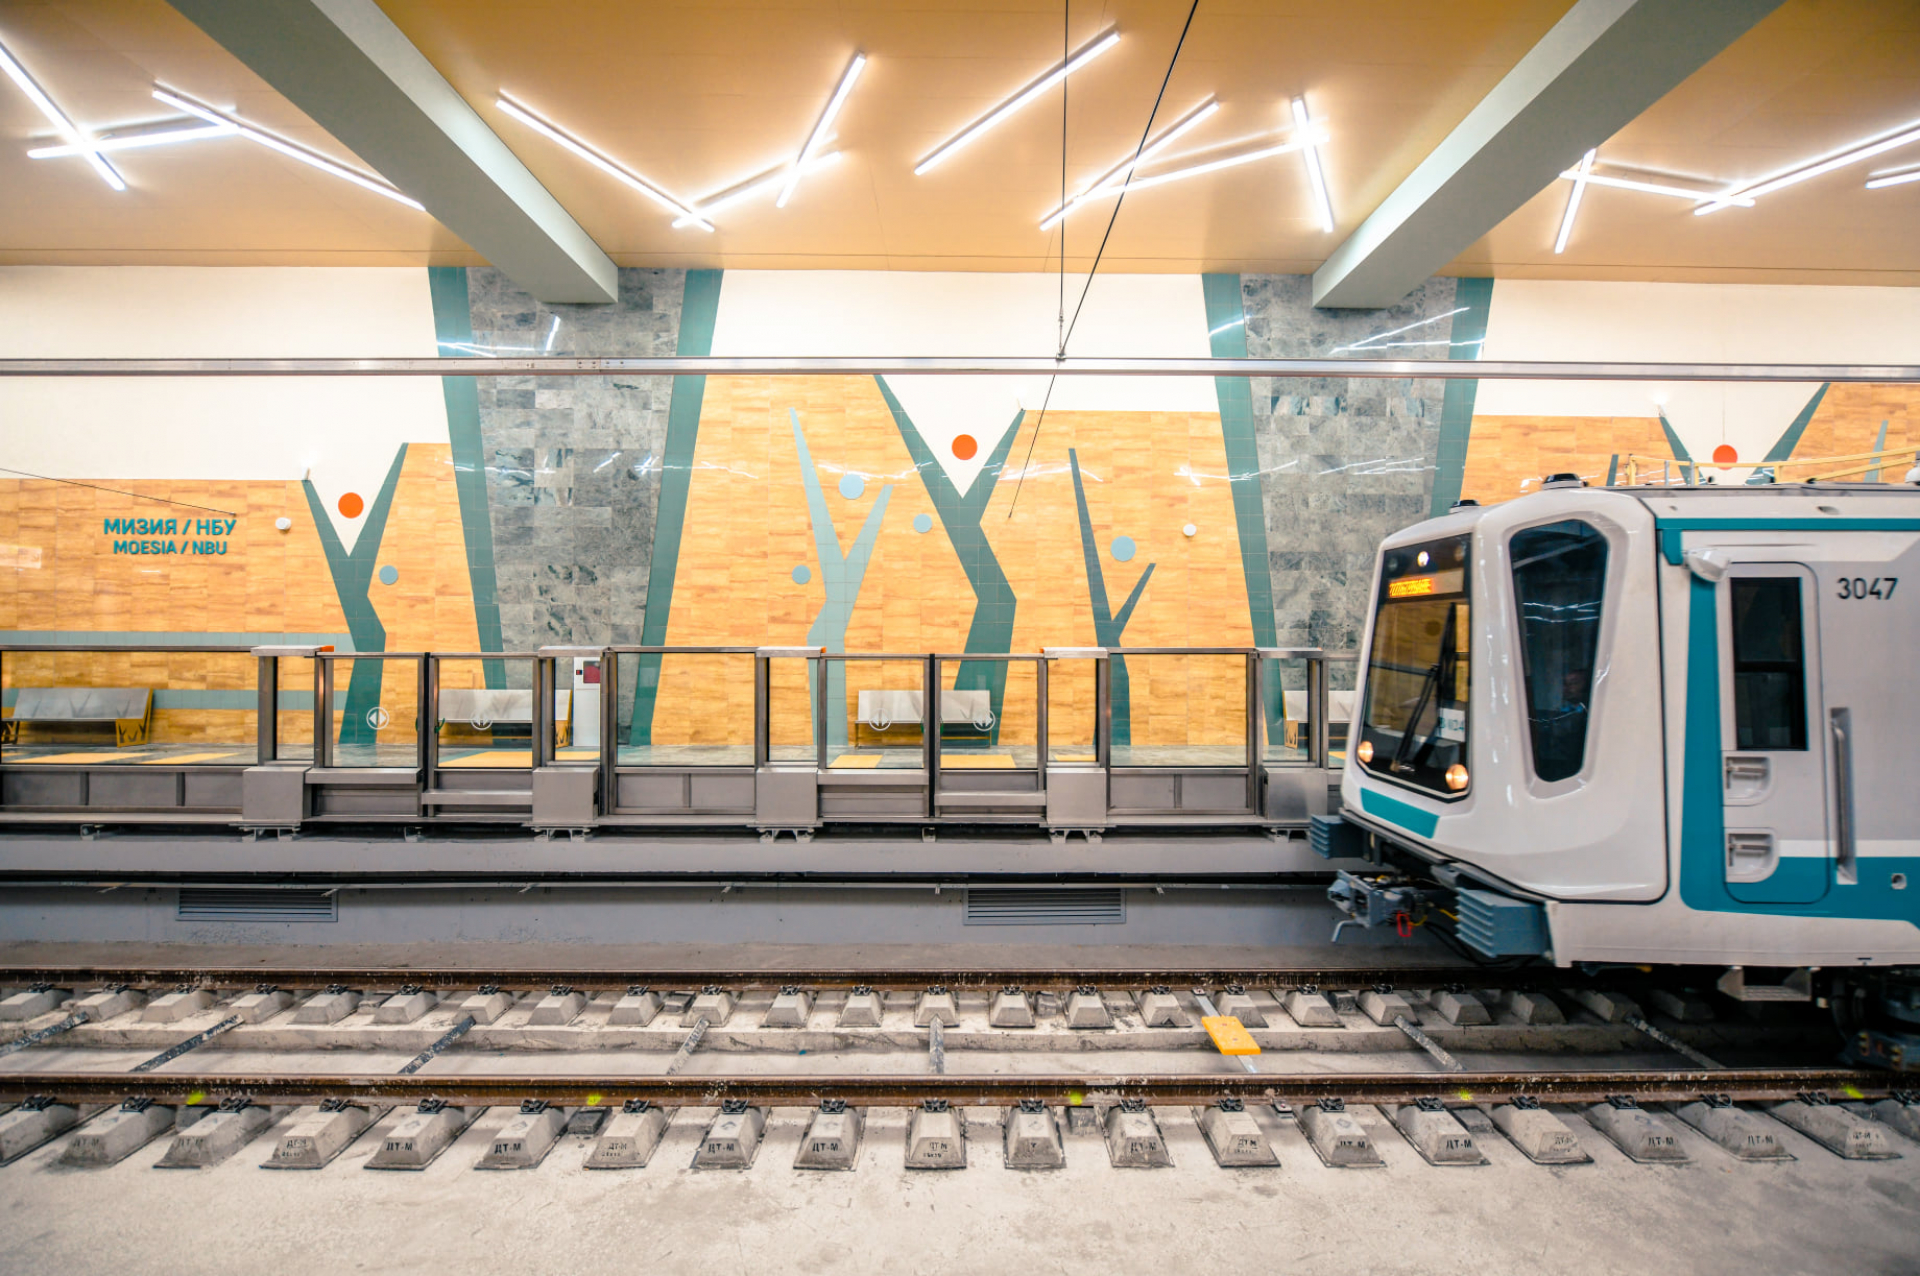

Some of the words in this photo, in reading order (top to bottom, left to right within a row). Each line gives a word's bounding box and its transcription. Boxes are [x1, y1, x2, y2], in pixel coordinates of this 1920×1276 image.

[104, 518, 177, 535] МИЗИЯ
[182, 519, 191, 535] /
[196, 519, 237, 536] НБУ
[113, 540, 177, 555] MOESIA
[180, 541, 188, 555] /
[192, 541, 227, 555] NBU
[1836, 577, 1899, 600] 3047
